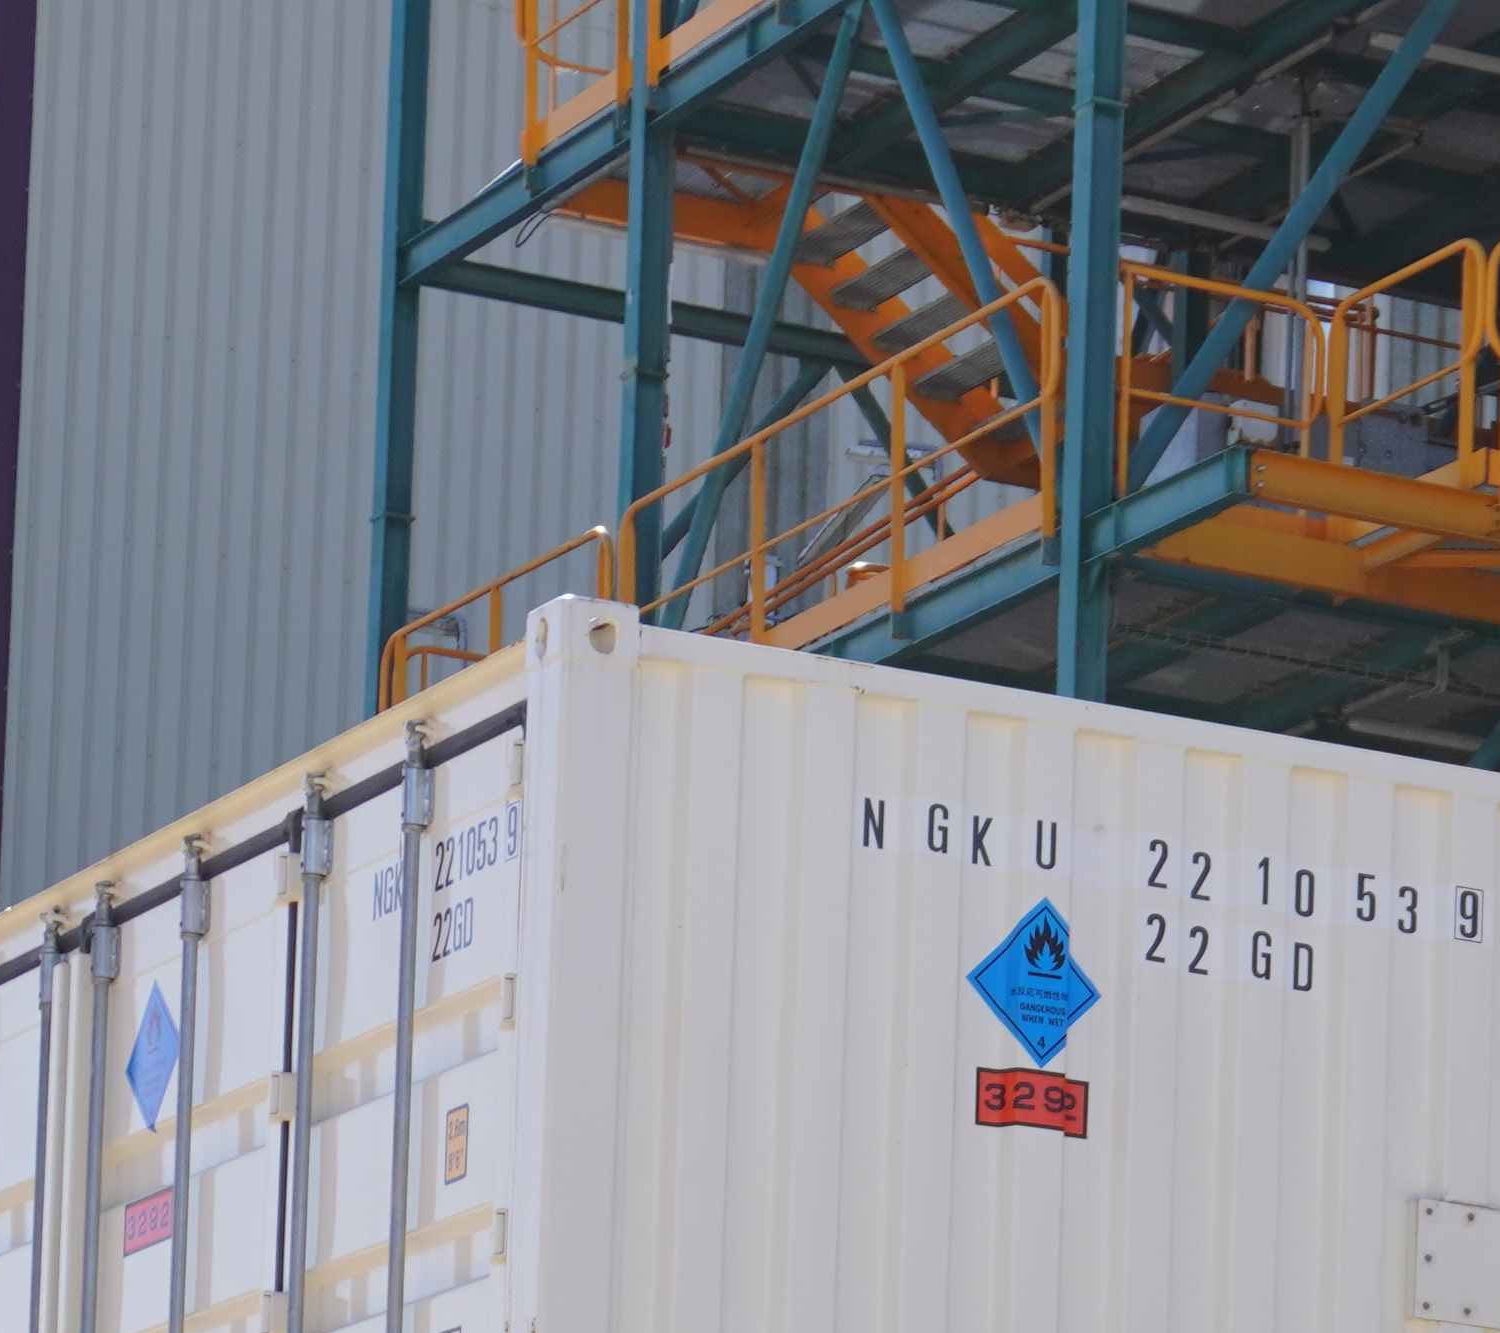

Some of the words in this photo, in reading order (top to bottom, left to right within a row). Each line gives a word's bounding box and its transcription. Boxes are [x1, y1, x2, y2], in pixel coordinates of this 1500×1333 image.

[372, 860, 404, 922] NGK
[1037, 1036, 1046, 1050] 4
[128, 1200, 170, 1241] 3292
